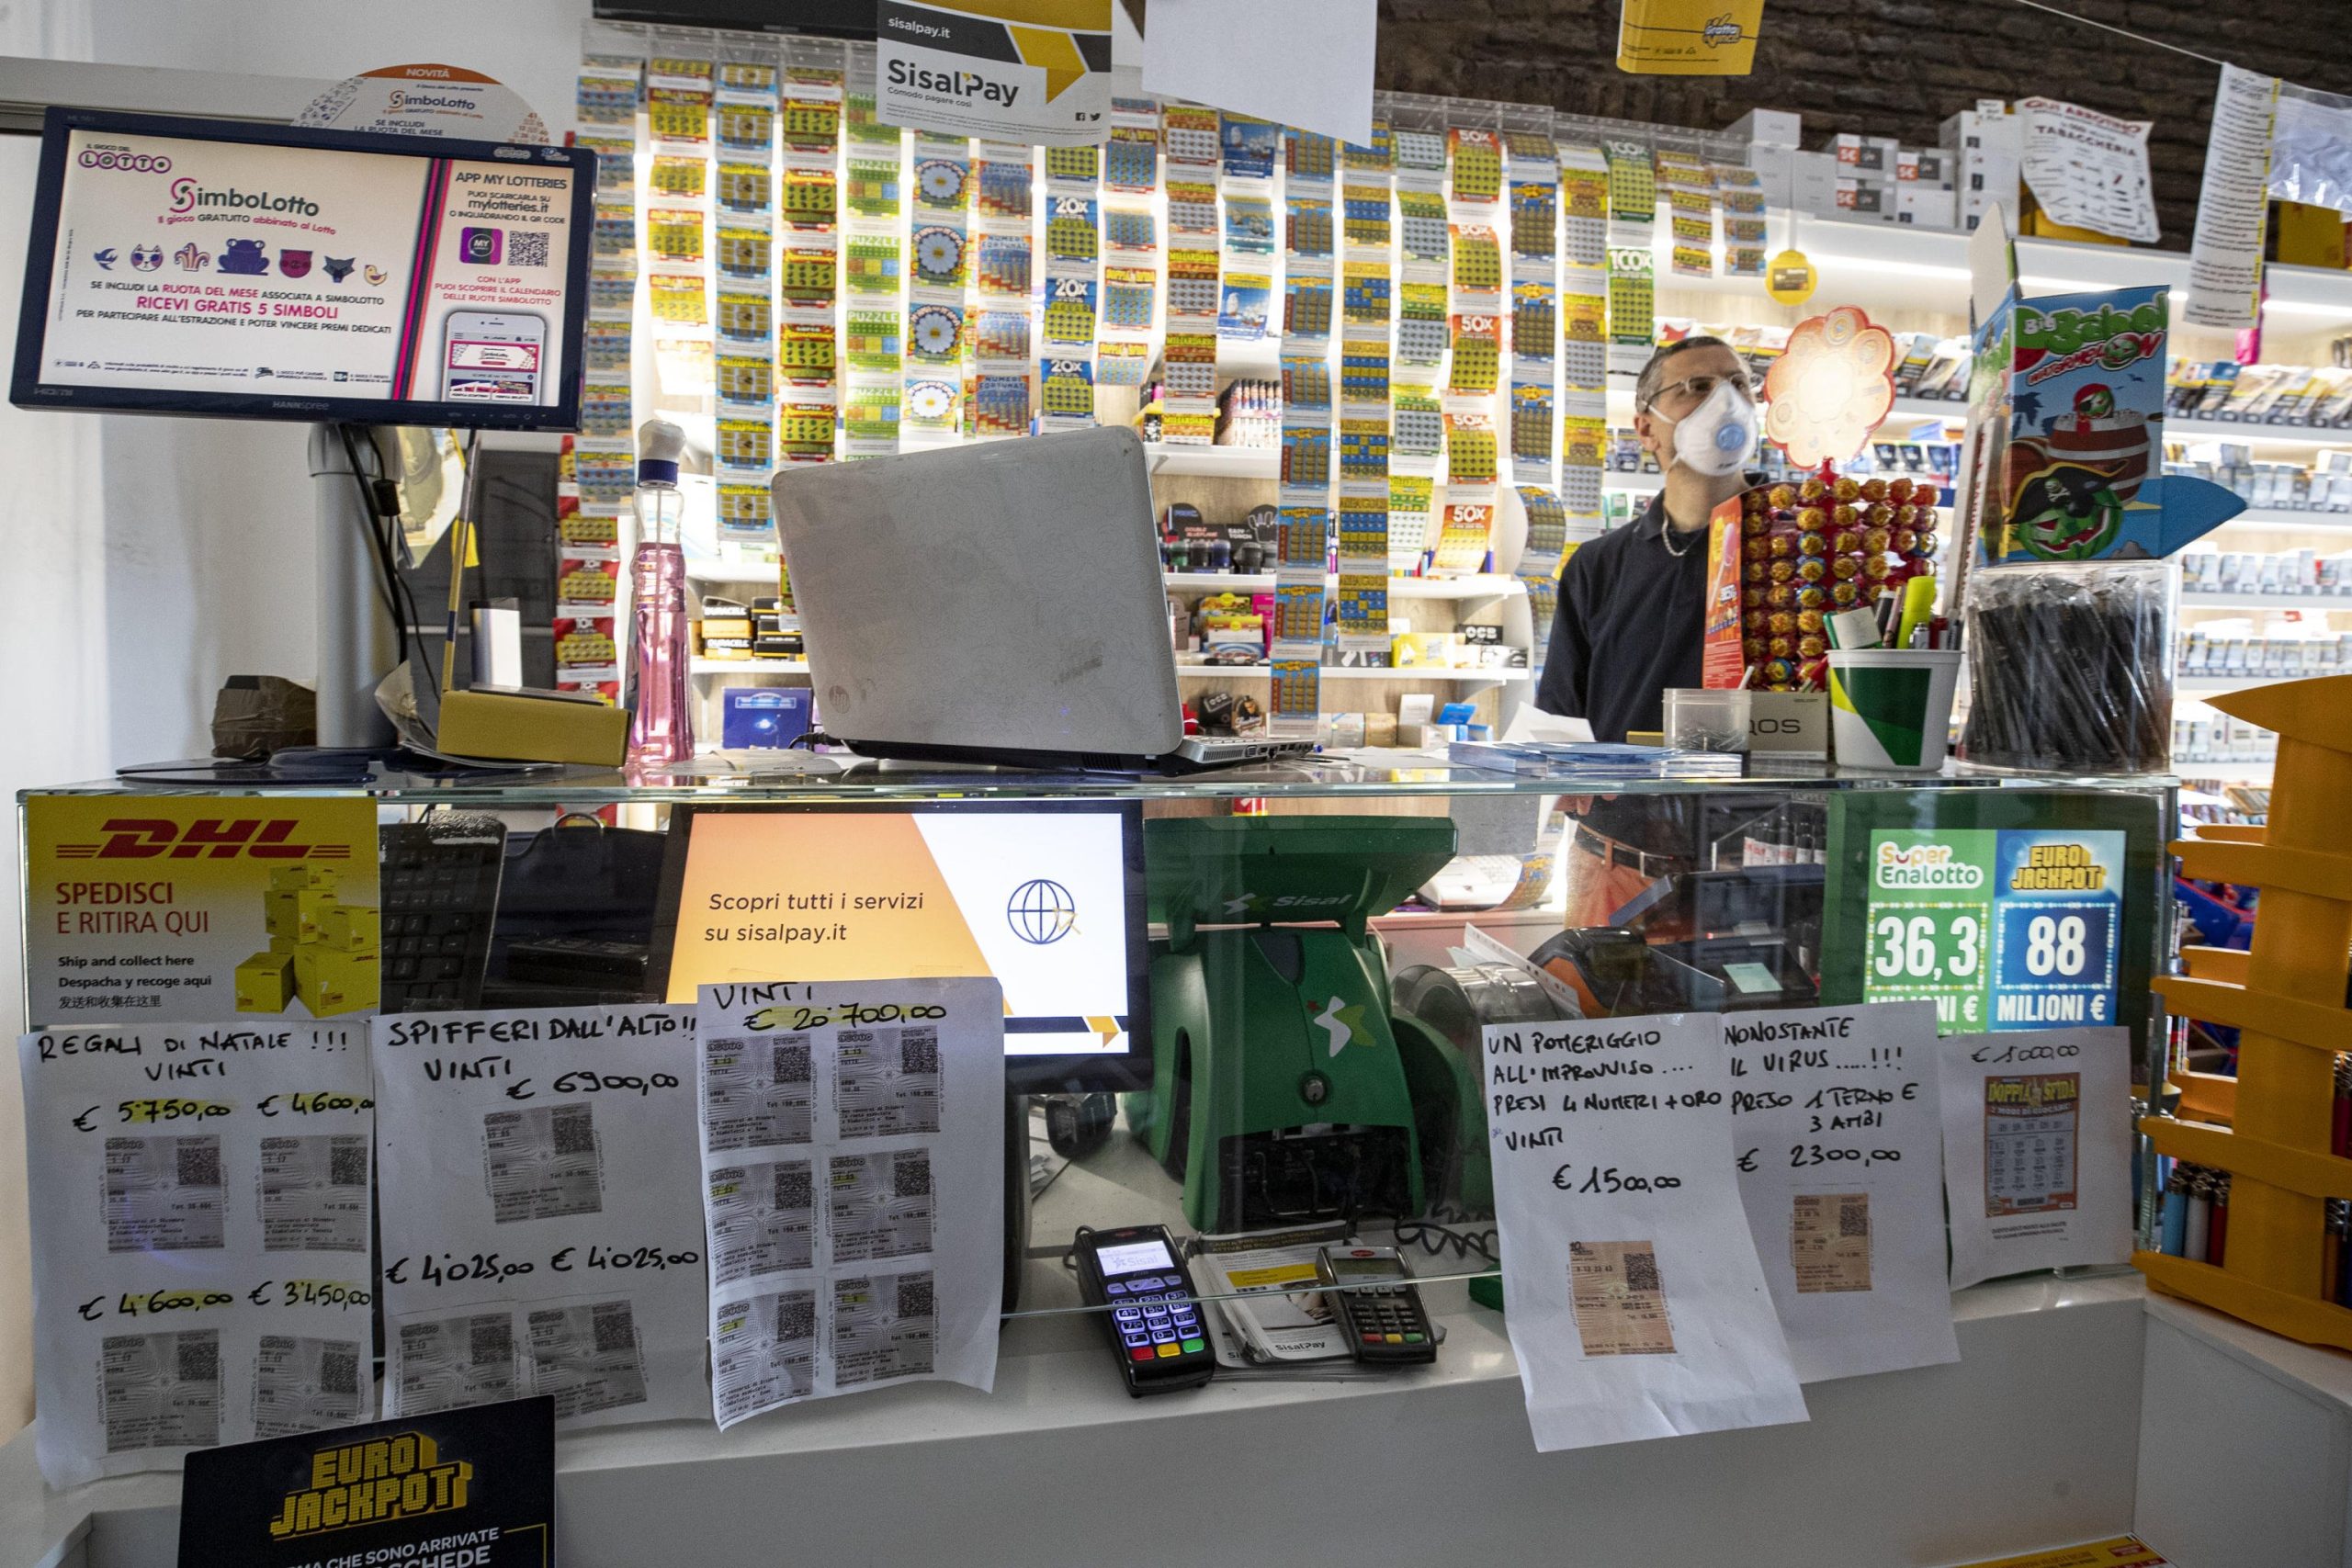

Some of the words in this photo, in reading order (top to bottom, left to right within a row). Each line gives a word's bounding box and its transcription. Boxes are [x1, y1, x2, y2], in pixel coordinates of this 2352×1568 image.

[888, 16, 951, 39] sisalpay.it
[887, 59, 1020, 107] SisalPay
[389, 90, 476, 109] SimboLotto
[887, 86, 923, 99] Comodo
[924, 95, 954, 107] pagare
[955, 98, 972, 108] così
[368, 126, 399, 134] RUOTA
[456, 173, 481, 183] APP
[484, 174, 504, 185] MY
[507, 175, 567, 189] LOTTERIES
[169, 177, 320, 218] SimboLotto
[469, 198, 548, 213] mylotteries.it
[491, 192, 537, 201] SCARICARLA
[166, 215, 196, 226] gioco
[198, 213, 250, 223] GRATUITO
[253, 216, 298, 229] abbinato
[312, 224, 336, 235] Lotto
[458, 211, 520, 221] INQUADRANDO
[529, 215, 542, 223] QR
[847, 236, 899, 246] PUZZLE
[435, 283, 457, 291] PUOI
[458, 285, 498, 293] SCOPRIRE
[509, 288, 561, 297] CALENDARIO
[497, 276, 521, 285] L'APP
[90, 281, 103, 289] SE
[106, 282, 145, 292] INCLUDI
[162, 285, 202, 295] RUOTA
[205, 286, 225, 296] DEL
[229, 288, 259, 299] MESE
[262, 291, 313, 301] ASSOCIATA
[325, 294, 385, 305] SIMBOLOTTO
[443, 293, 467, 301] DELLE
[469, 294, 496, 302] RUOTE
[498, 296, 551, 305] SIMBOLOTTO
[137, 296, 188, 311] RICEVI
[195, 298, 252, 315] GRATIS
[258, 302, 267, 315] 5
[273, 303, 338, 319] SIMBOLI
[76, 310, 96, 319] PER
[97, 310, 160, 322] PARTECIPARE
[162, 312, 238, 325] ALL'ESTRAZIONE
[247, 318, 277, 328] POTER
[279, 320, 319, 331] VINCERE
[322, 321, 349, 332] PREMI
[351, 323, 391, 334] DEDICATI
[1465, 626, 1497, 638] OCB
[96, 818, 311, 859] DHL
[1881, 845, 1948, 868] Super
[2030, 844, 2091, 868] EURO
[1881, 865, 1978, 886] Enalotto
[2010, 865, 2106, 891] JACKPOT
[56, 882, 173, 904] SPEDISCI
[709, 893, 781, 913] Scopri
[787, 893, 835, 909] tutti
[841, 893, 847, 909] i
[854, 892, 923, 909] servizi
[1272, 893, 1351, 908] Sisal
[58, 912, 70, 933] E
[80, 911, 156, 933] RITIRA
[165, 911, 209, 937] QUI
[705, 927, 730, 942] su
[736, 923, 847, 944] sisalpay.it
[1874, 916, 1979, 981] 36,3
[2026, 916, 2086, 976] 88
[59, 956, 87, 968] Ship
[91, 955, 116, 966] and
[119, 955, 163, 966] collect
[165, 955, 194, 965] here
[59, 976, 121, 989] Despacha
[125, 978, 133, 989] y
[137, 977, 180, 988] recoge
[713, 982, 812, 1010] VINTI
[1962, 995, 1978, 1021] €
[1996, 995, 2084, 1022] MILIONI
[2090, 994, 2106, 1021] €
[743, 1009, 775, 1031] €
[1724, 1017, 1855, 1046] NONOSTANTE
[389, 1019, 539, 1046] SPIFFERI
[1488, 1032, 1521, 1055] UN
[1532, 1031, 1661, 1054] POMERIGGIO
[38, 1035, 141, 1063] REGALI
[165, 1037, 186, 1052] DI
[200, 1031, 291, 1051] NATALE
[1971, 1046, 1991, 1063] €
[145, 1059, 225, 1081] VINTI
[424, 1056, 511, 1081] VINTI
[1731, 1057, 1747, 1077] IL
[506, 1077, 535, 1100] €
[553, 1071, 679, 1096] 6900,00
[257, 1094, 279, 1117] €
[1494, 1095, 1545, 1116] PRESI
[1563, 1095, 1577, 1112] 4
[1584, 1094, 1657, 1111] NUMERI
[1731, 1090, 1792, 1115] PRESO
[1804, 1089, 1823, 1109] 1
[1826, 1087, 1894, 1107] TERNO
[73, 1106, 100, 1132] €
[1808, 1115, 1823, 1133] 3
[1830, 1110, 1882, 1131] AMBI
[1506, 1126, 1563, 1151] VINTI
[1737, 1148, 1759, 1172] €
[1791, 1145, 1901, 1168] 2300,00
[1553, 1165, 1572, 1191] €
[1579, 1167, 1681, 1194] 1500,00
[385, 1257, 410, 1284] €
[550, 1247, 576, 1272] €
[249, 1281, 273, 1305] €
[78, 1296, 105, 1320] €
[1275, 1341, 1326, 1351] SisalPay
[311, 1431, 437, 1490] EURO
[269, 1461, 473, 1540] JACKPOT
[327, 1553, 362, 1568] CHE
[365, 1543, 415, 1564] SONO
[418, 1527, 500, 1554] ARRIVATE
